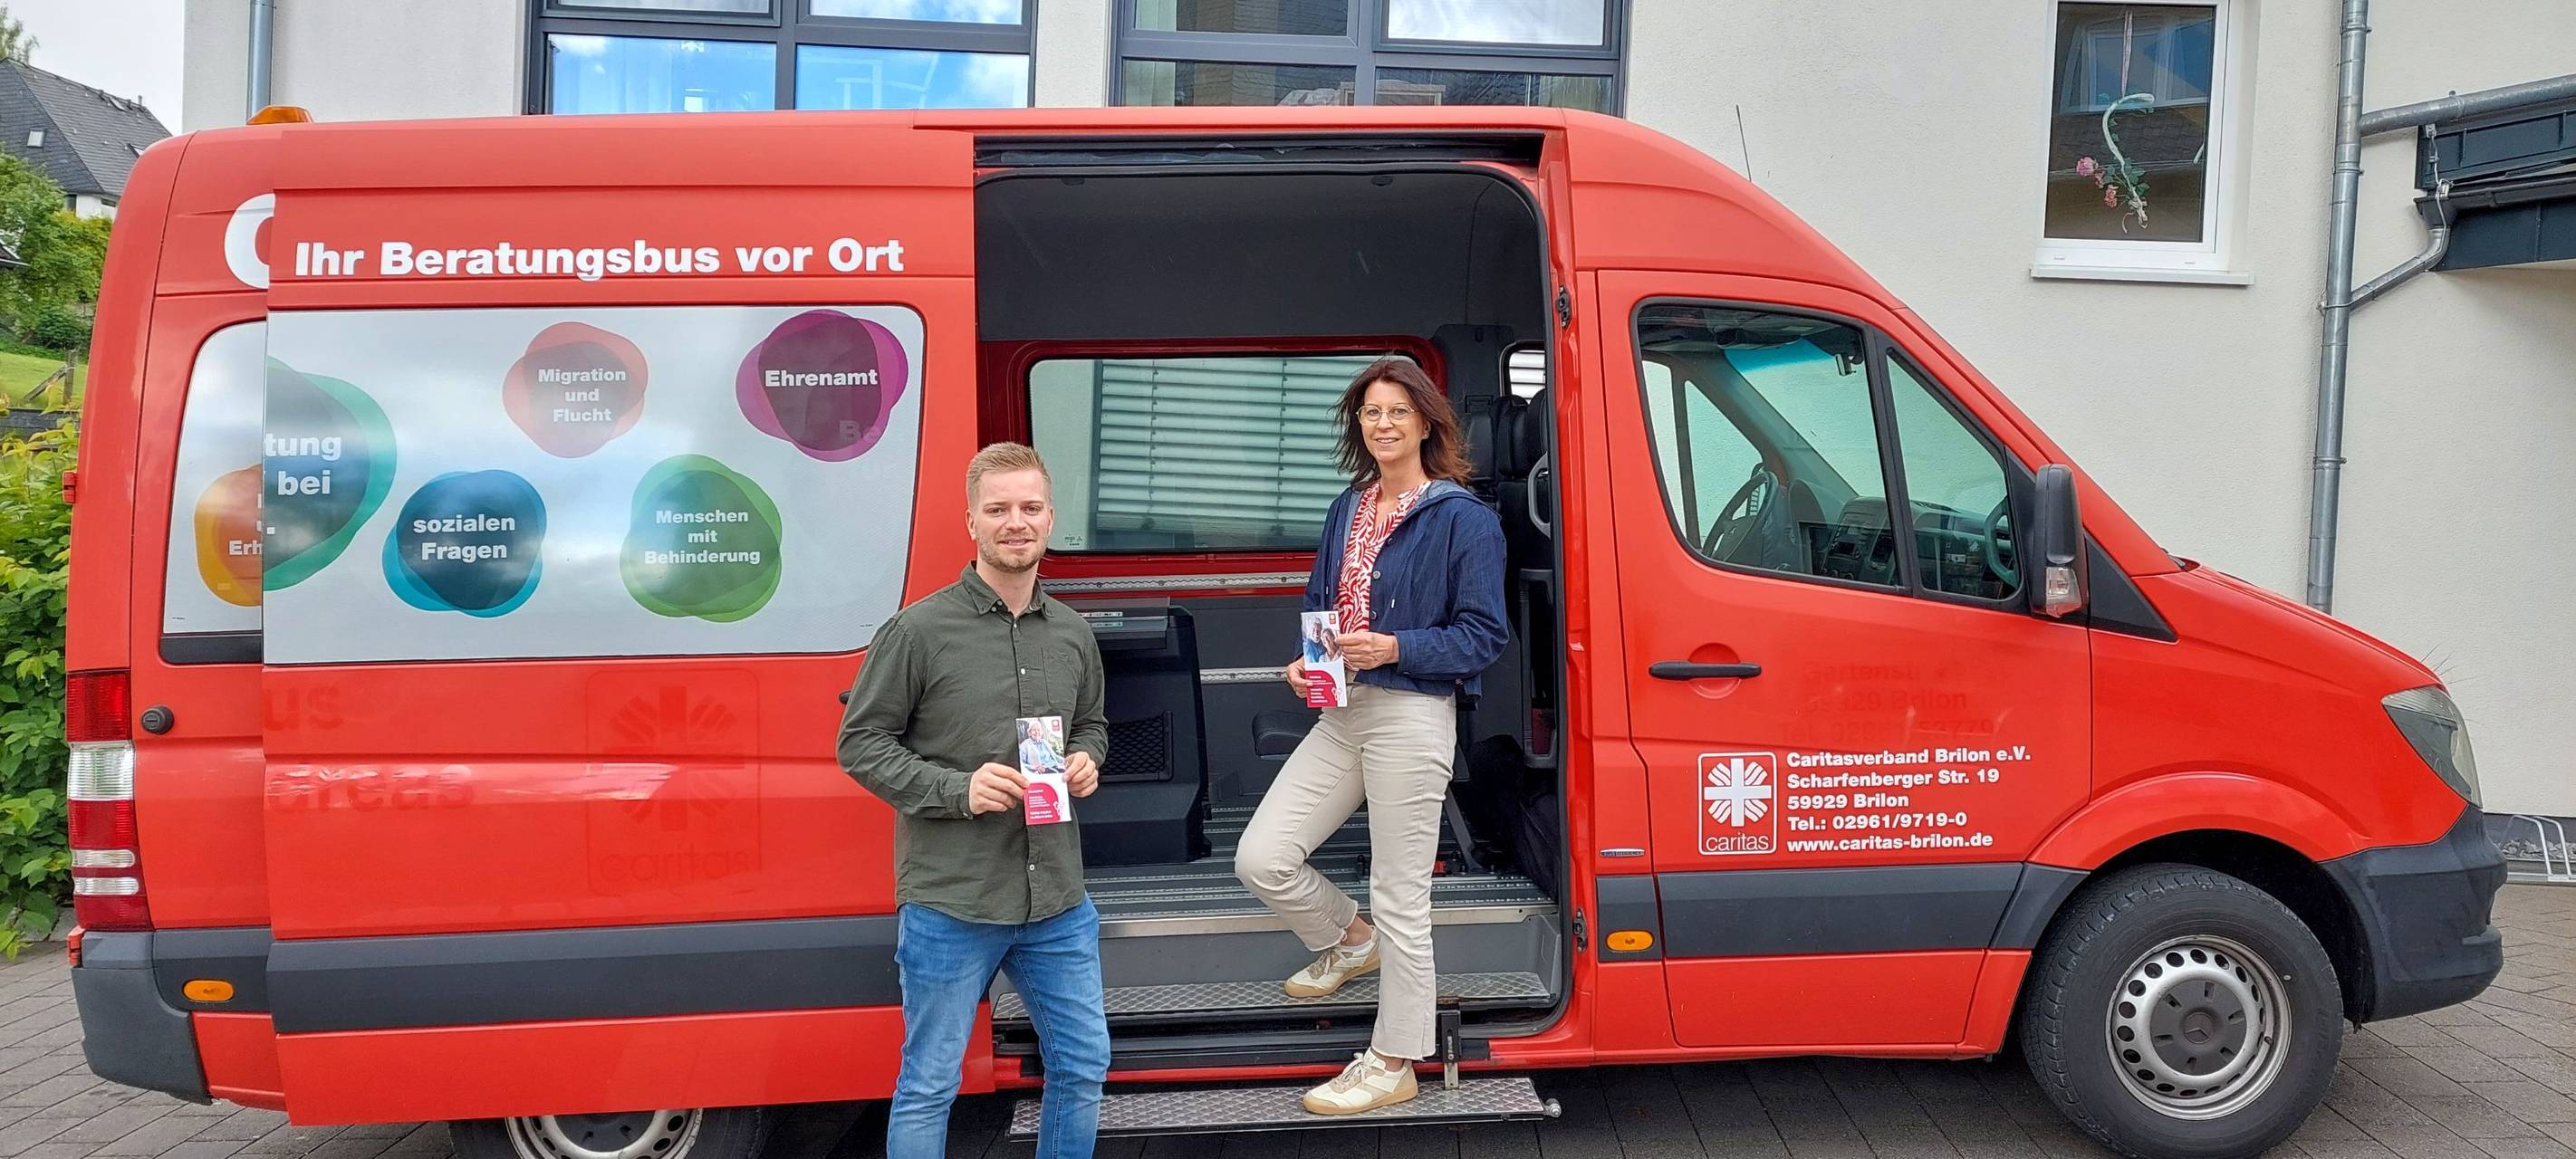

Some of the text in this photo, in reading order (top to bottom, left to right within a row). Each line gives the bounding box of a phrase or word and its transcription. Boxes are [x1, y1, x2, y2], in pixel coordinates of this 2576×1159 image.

[296, 238, 904, 281] Ihr Beratungsbus vor Ort
[537, 369, 627, 385] Migration
[764, 369, 878, 388] Ehrenamt
[565, 388, 599, 403] und
[552, 407, 611, 423] Flucht
[264, 433, 341, 462] tung
[277, 469, 331, 495] bei
[413, 513, 515, 533] sozialen
[655, 510, 748, 525] Menschen
[687, 529, 718, 543] mit
[422, 542, 507, 563] Fragen
[644, 549, 761, 565] Behinderung
[1787, 745, 2031, 768] Caritasverband Brilon e.V.
[1787, 769, 2000, 789] Scharfenberger Str. 19
[1787, 793, 1909, 810] 59929 Brilon
[1787, 812, 1967, 831] Tel.: 02961/9719-0
[1706, 832, 1769, 851] caritas
[1787, 833, 1994, 852] www.caritas-brilon.de
